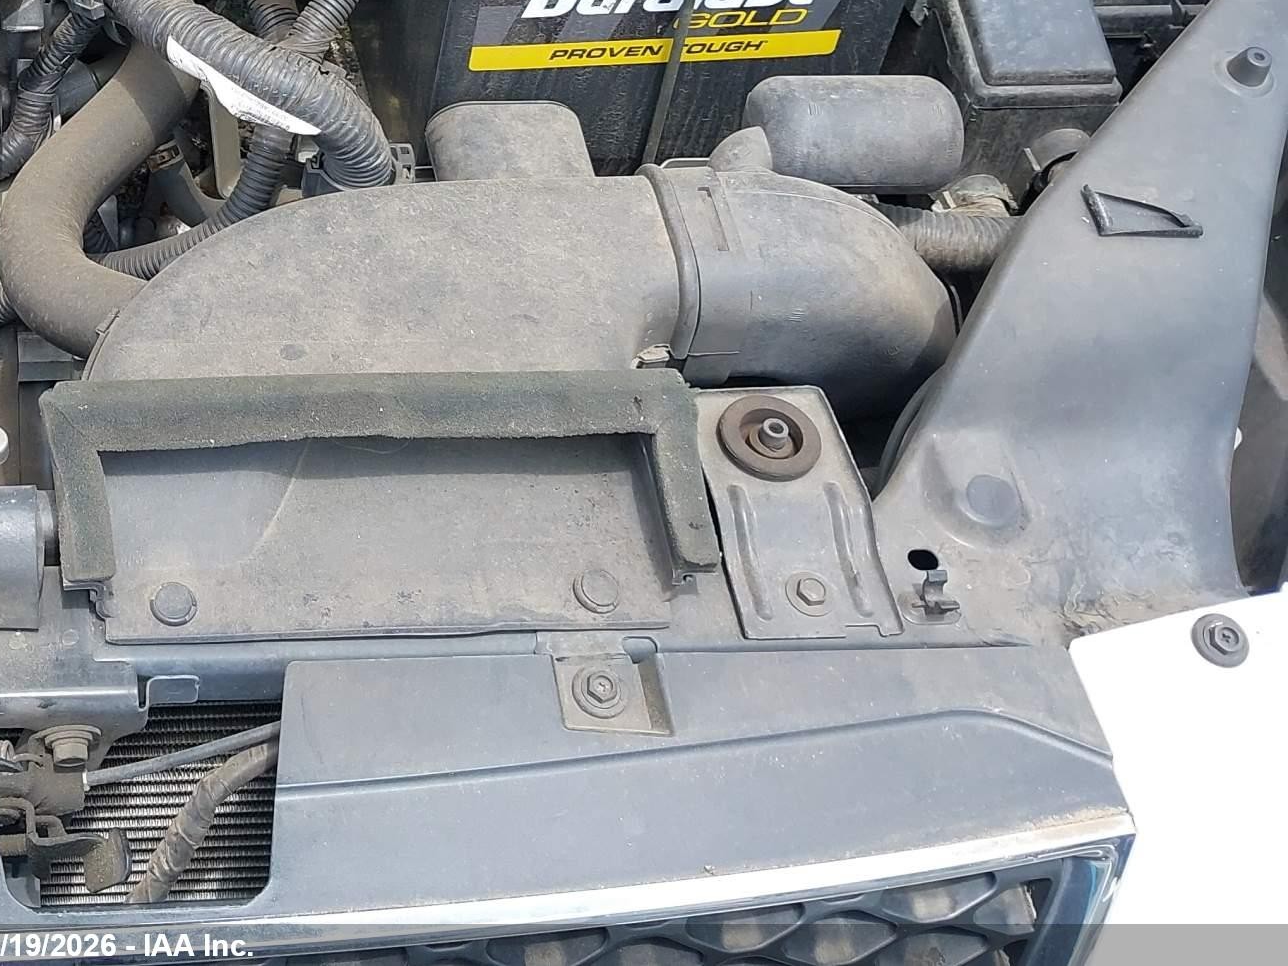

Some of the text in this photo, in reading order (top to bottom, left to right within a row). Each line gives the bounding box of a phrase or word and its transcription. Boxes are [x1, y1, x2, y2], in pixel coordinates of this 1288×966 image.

[673, 8, 808, 30] GOLD
[548, 44, 663, 60] PROVEN
[682, 39, 762, 55] OUGH
